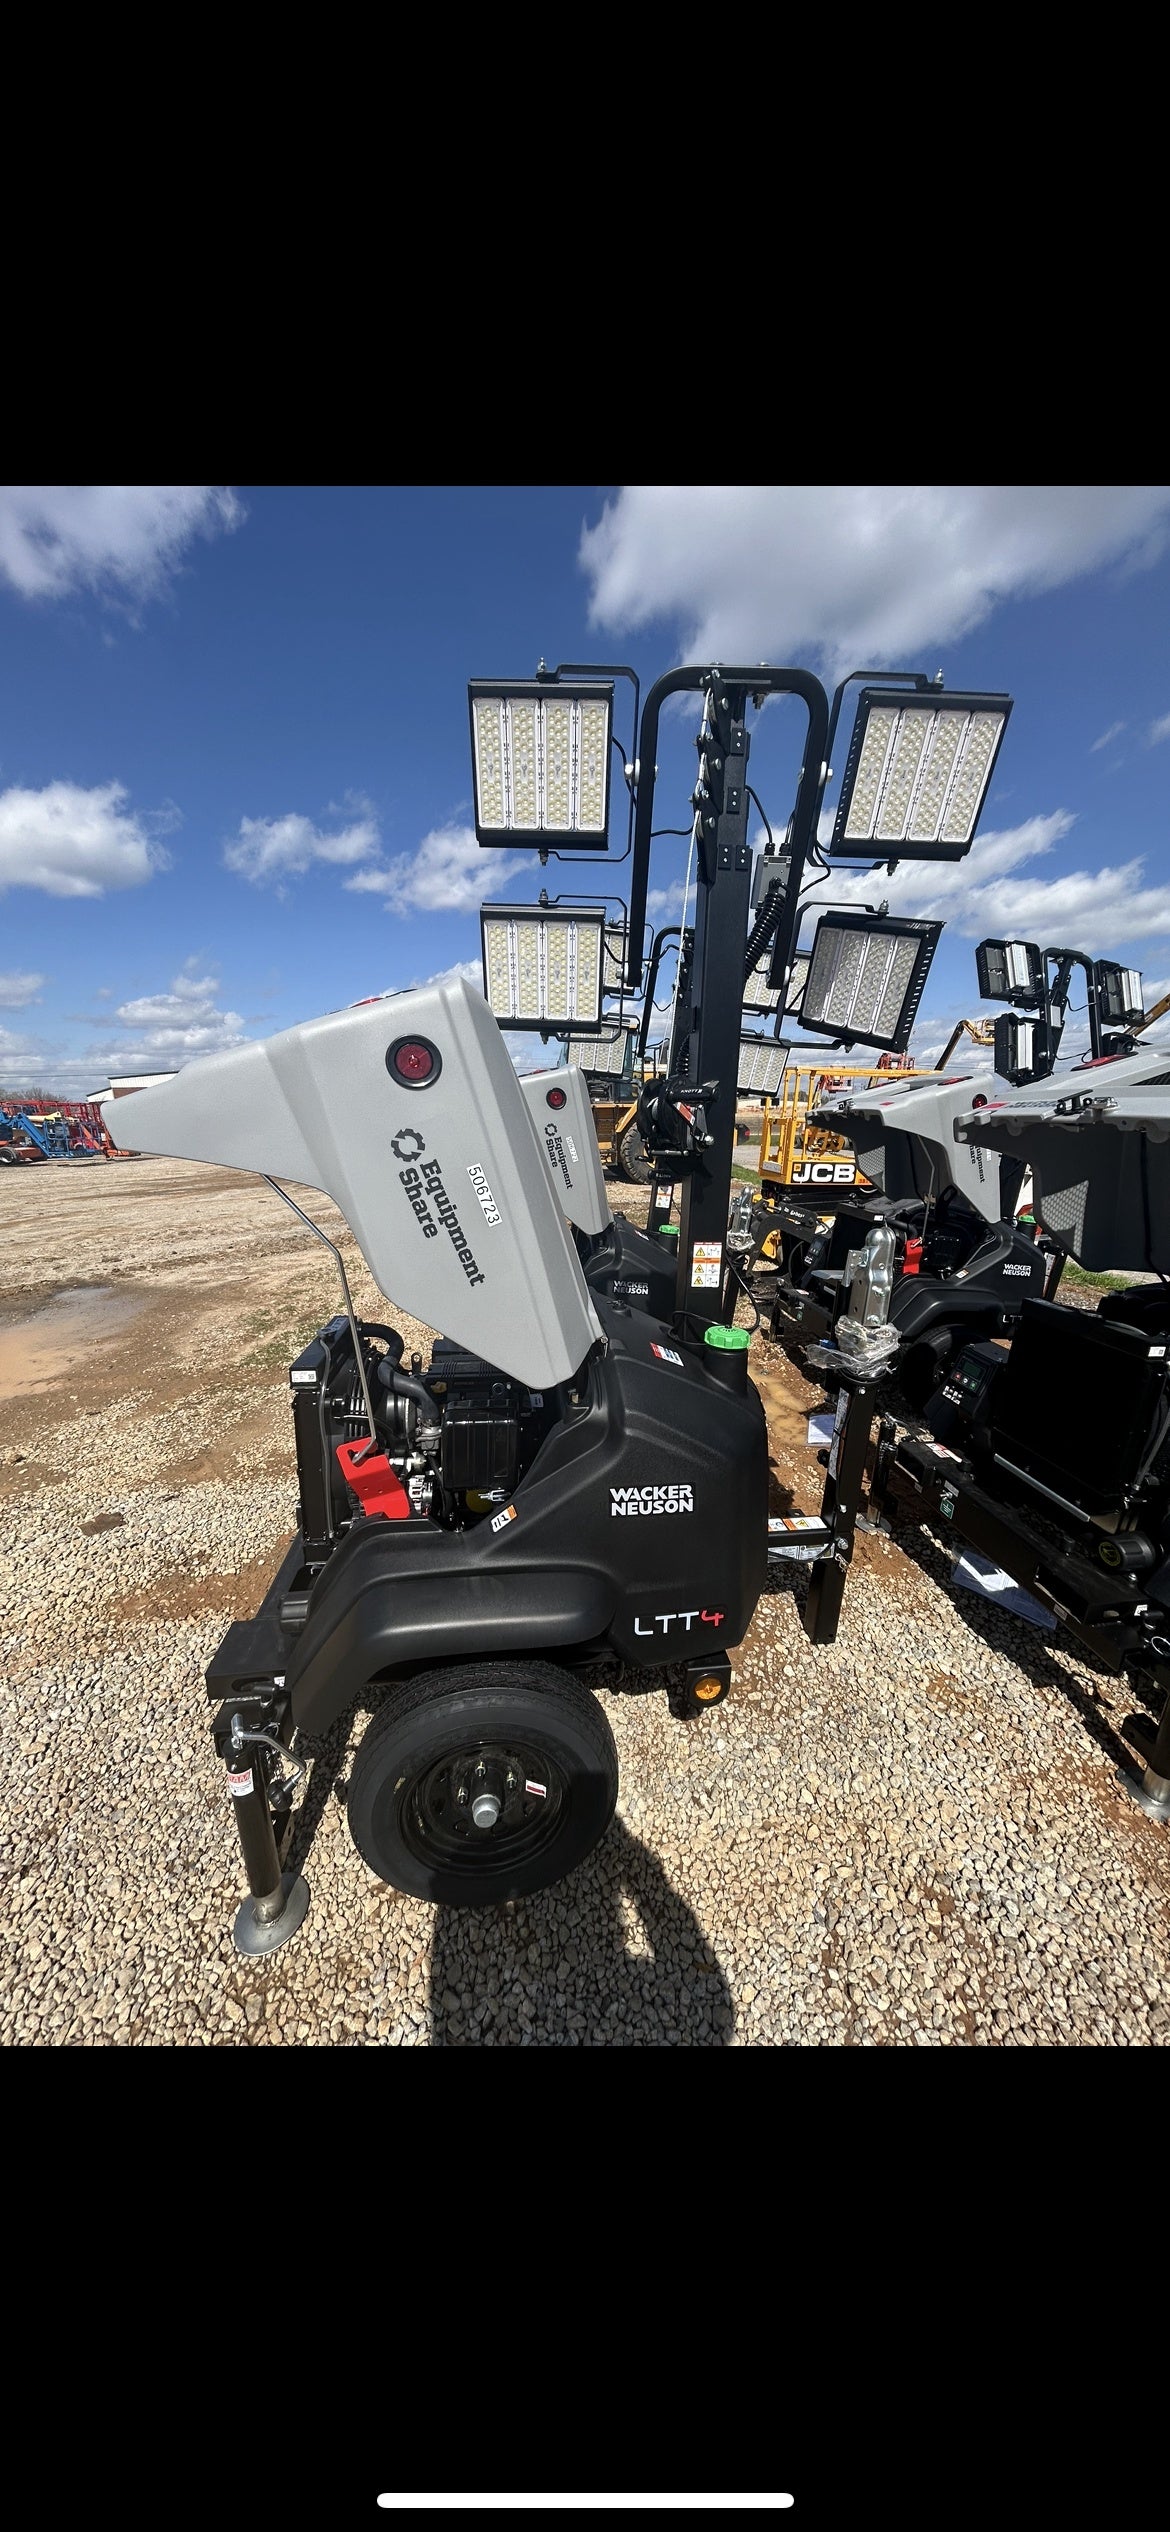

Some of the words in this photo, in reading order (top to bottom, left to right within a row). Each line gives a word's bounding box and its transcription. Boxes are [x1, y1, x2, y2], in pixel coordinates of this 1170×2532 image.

[546, 1138, 558, 1168] Share
[554, 1136, 573, 1189] Equipment
[793, 1163, 856, 1182] JCB
[975, 1146, 985, 1183] uipment
[399, 1167, 438, 1239] Share
[468, 1166, 500, 1224] 506723
[420, 1158, 485, 1287] Equipment
[1002, 1269, 1031, 1277] NEUSON
[1004, 1263, 1031, 1271] WACKER
[613, 1280, 648, 1289] WACKER
[613, 1286, 648, 1295] NEUSON
[1002, 1314, 1023, 1323] LTT
[609, 1484, 694, 1502] WACKER
[611, 1498, 694, 1516] NEUSON
[634, 1610, 724, 1636] LTT4
